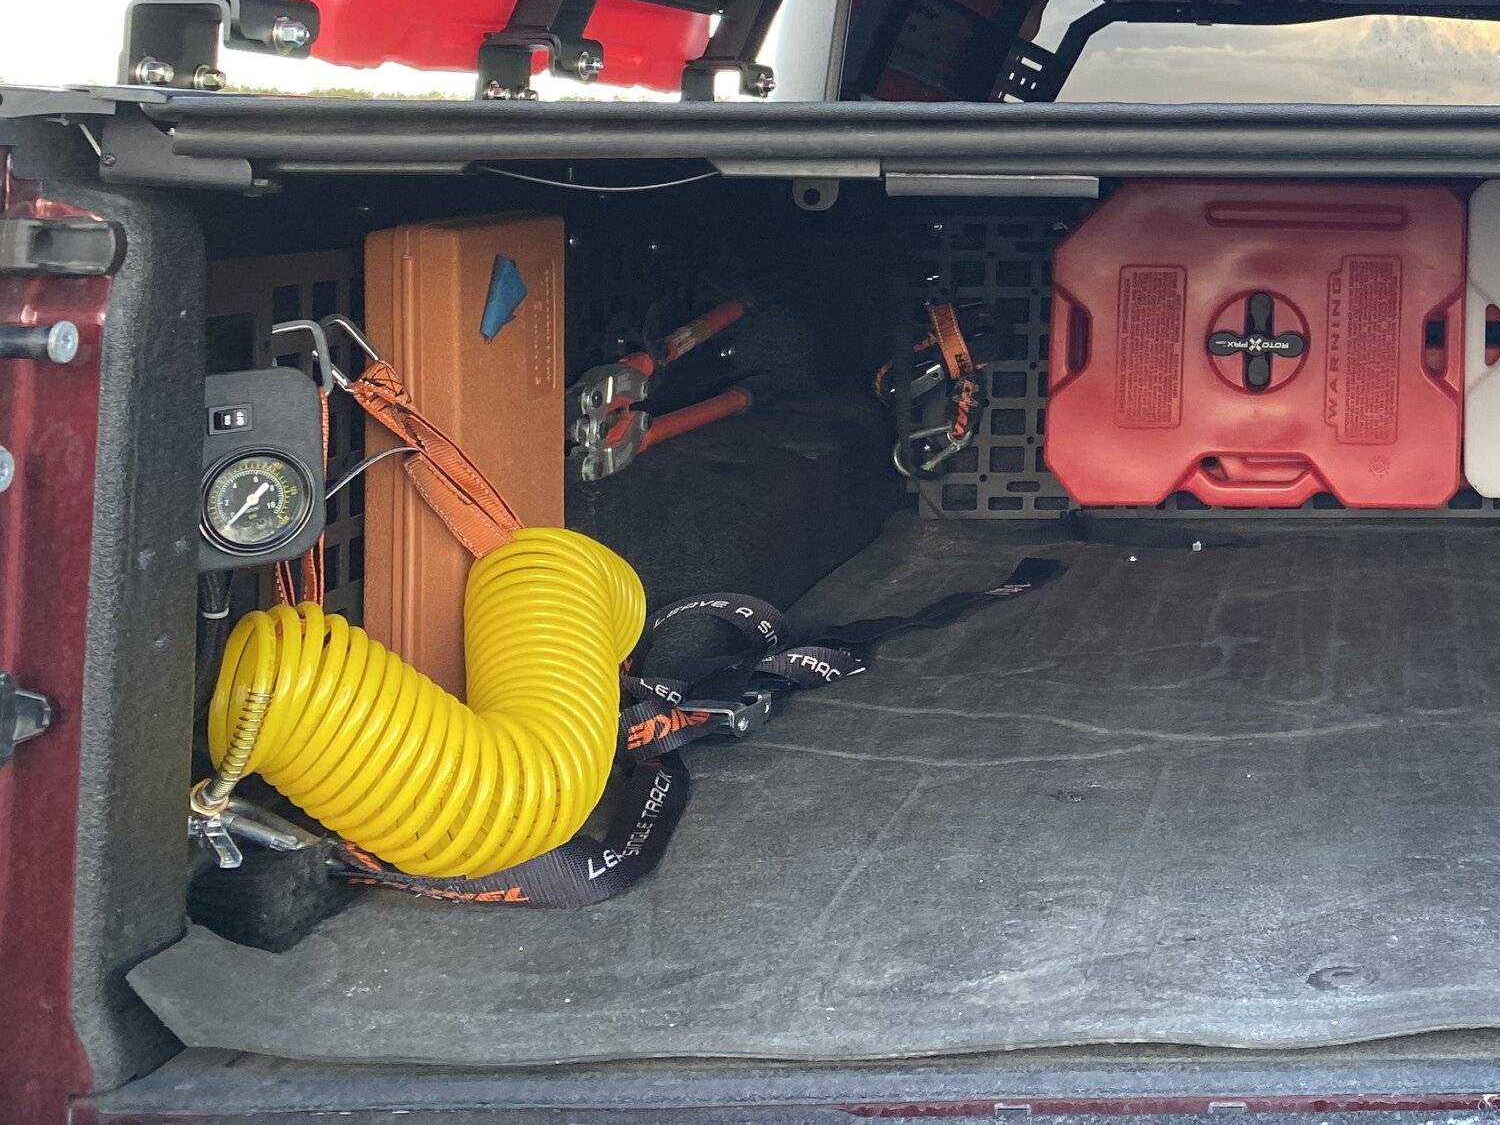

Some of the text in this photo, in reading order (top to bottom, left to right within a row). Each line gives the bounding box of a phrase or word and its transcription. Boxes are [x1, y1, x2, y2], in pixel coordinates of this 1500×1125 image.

[1328, 277, 1342, 419] WARNING
[623, 769, 674, 858] SINGLE TRACK
